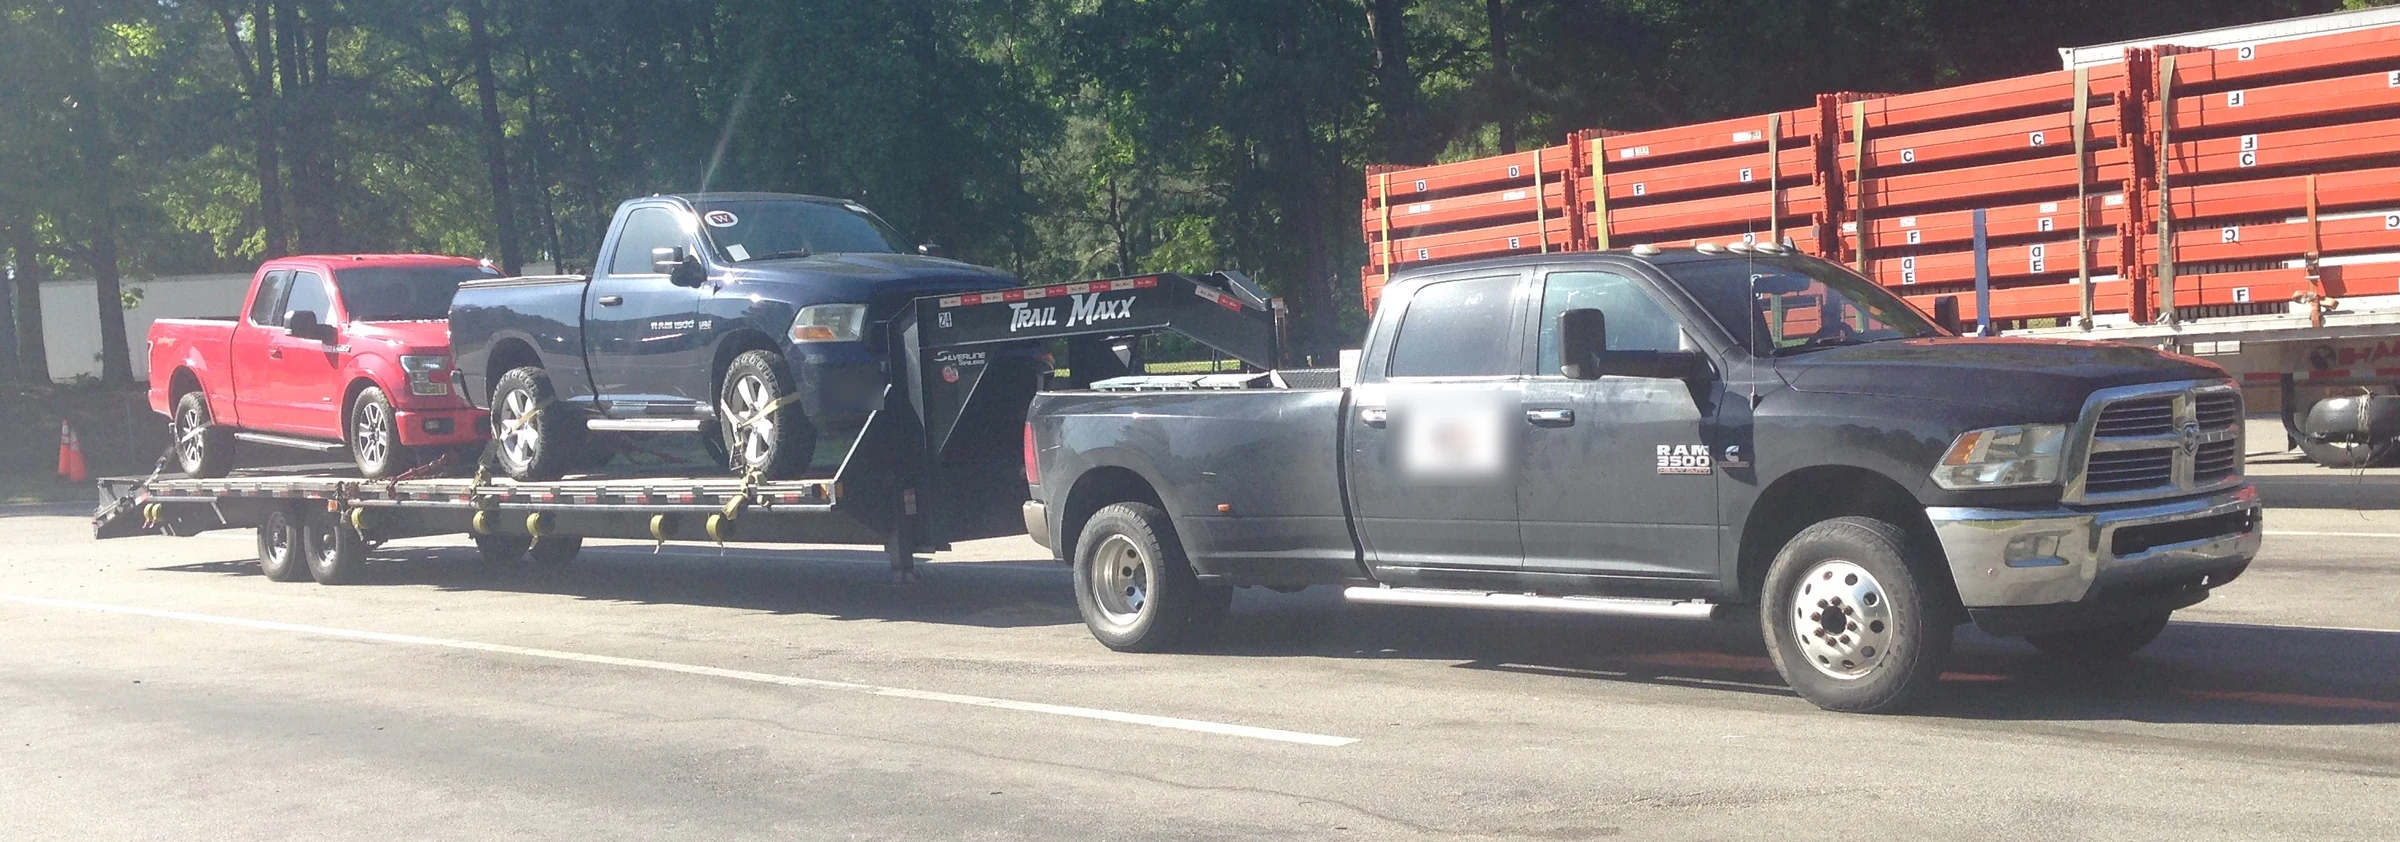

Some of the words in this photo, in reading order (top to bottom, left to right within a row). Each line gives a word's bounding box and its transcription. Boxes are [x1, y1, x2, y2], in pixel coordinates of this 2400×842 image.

[2241, 46, 2252, 59] C
[2231, 92, 2240, 105] F
[2032, 133, 2043, 146] C
[2244, 136, 2253, 149] F
[1903, 151, 1913, 162] C
[2242, 153, 2253, 165] C
[1510, 166, 1518, 177] D
[1742, 170, 1750, 181] F
[1418, 181, 1426, 191] D
[1635, 184, 1643, 194] F
[2041, 219, 2050, 231] F
[2388, 215, 2400, 227] C
[1910, 231, 1918, 243] F
[1510, 238, 1518, 249] E
[1420, 249, 1427, 259] E
[2033, 260, 2042, 271] E
[1905, 272, 1914, 283] E
[2236, 289, 2246, 301] F
[1656, 444, 1710, 456] RAM
[1656, 455, 1710, 467] 3500
